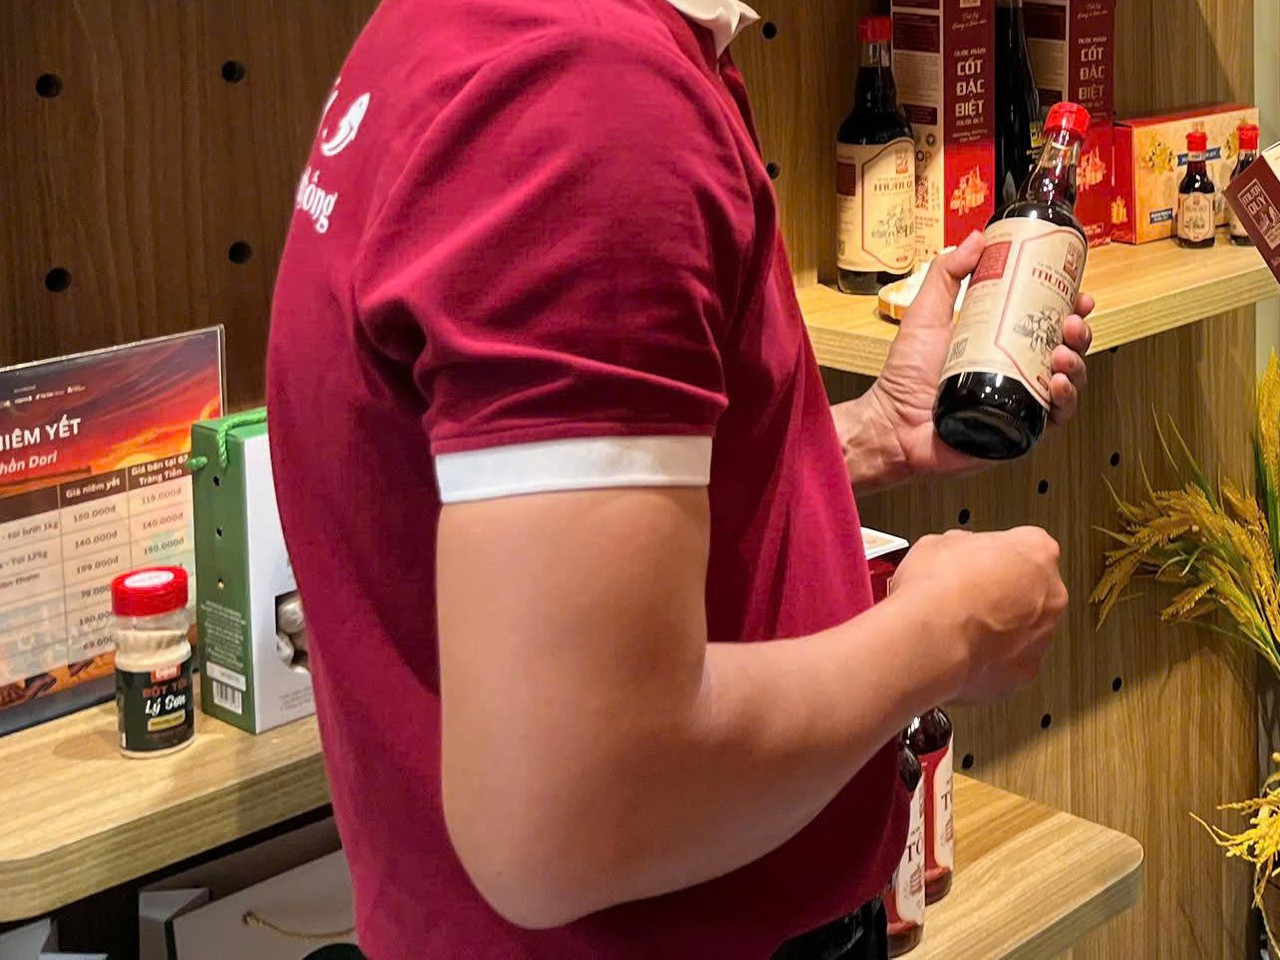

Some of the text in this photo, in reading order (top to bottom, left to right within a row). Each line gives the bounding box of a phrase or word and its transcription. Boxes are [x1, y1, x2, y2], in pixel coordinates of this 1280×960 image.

[1081, 44, 1105, 62] CỐT
[957, 56, 983, 76] CỐT
[1079, 64, 1106, 81] ĐẶC
[956, 78, 986, 97] ĐẶC
[1078, 83, 1105, 101] BIỆT
[955, 98, 985, 118] BIỆT
[45, 413, 82, 441] YẾT
[28, 450, 58, 469] Dori
[131, 465, 147, 476] Giá
[147, 460, 164, 473] bán
[164, 456, 177, 468] tại
[138, 468, 183, 487] Tràng Tiền
[66, 477, 121, 499] Giá niêm yết
[145, 697, 162, 717] Lý
